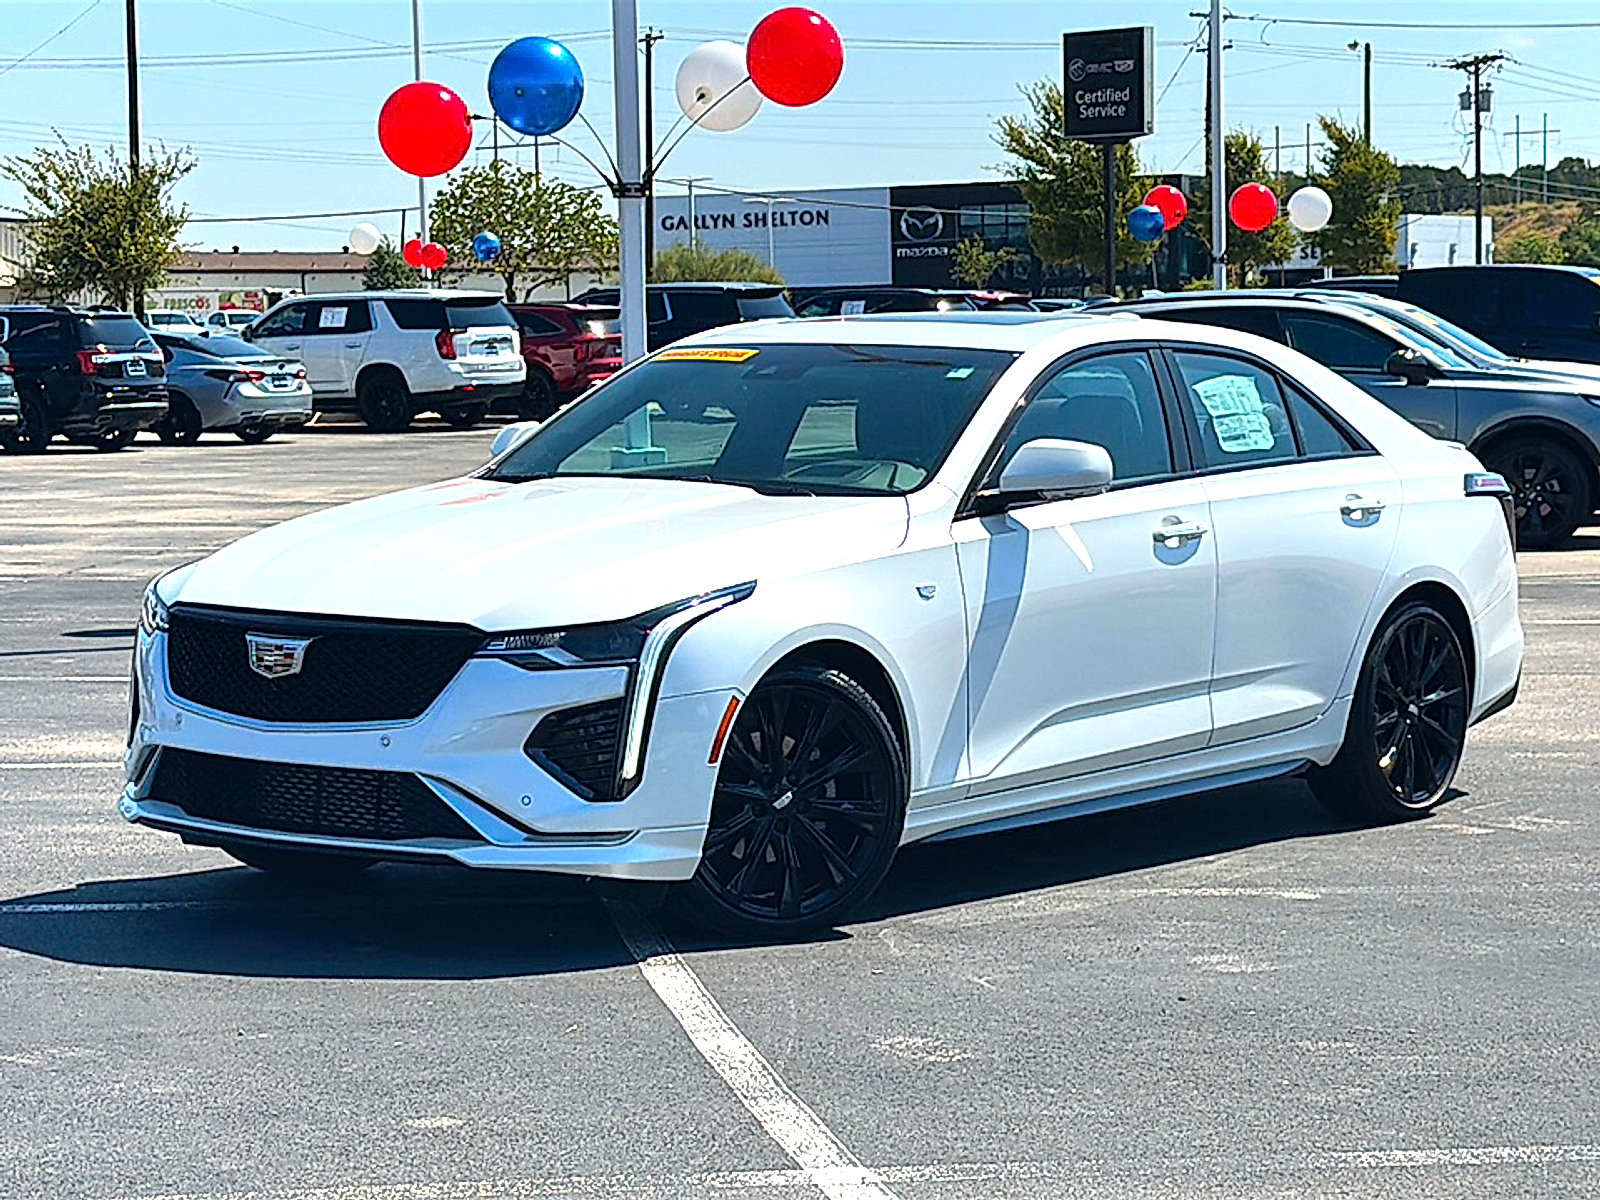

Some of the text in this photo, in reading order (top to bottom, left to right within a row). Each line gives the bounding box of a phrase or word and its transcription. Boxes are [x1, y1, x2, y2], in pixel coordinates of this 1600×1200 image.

[1075, 87, 1130, 104] Certified
[1079, 103, 1126, 118] Service
[743, 210, 829, 228] SHELTON
[896, 246, 949, 258] mazda
